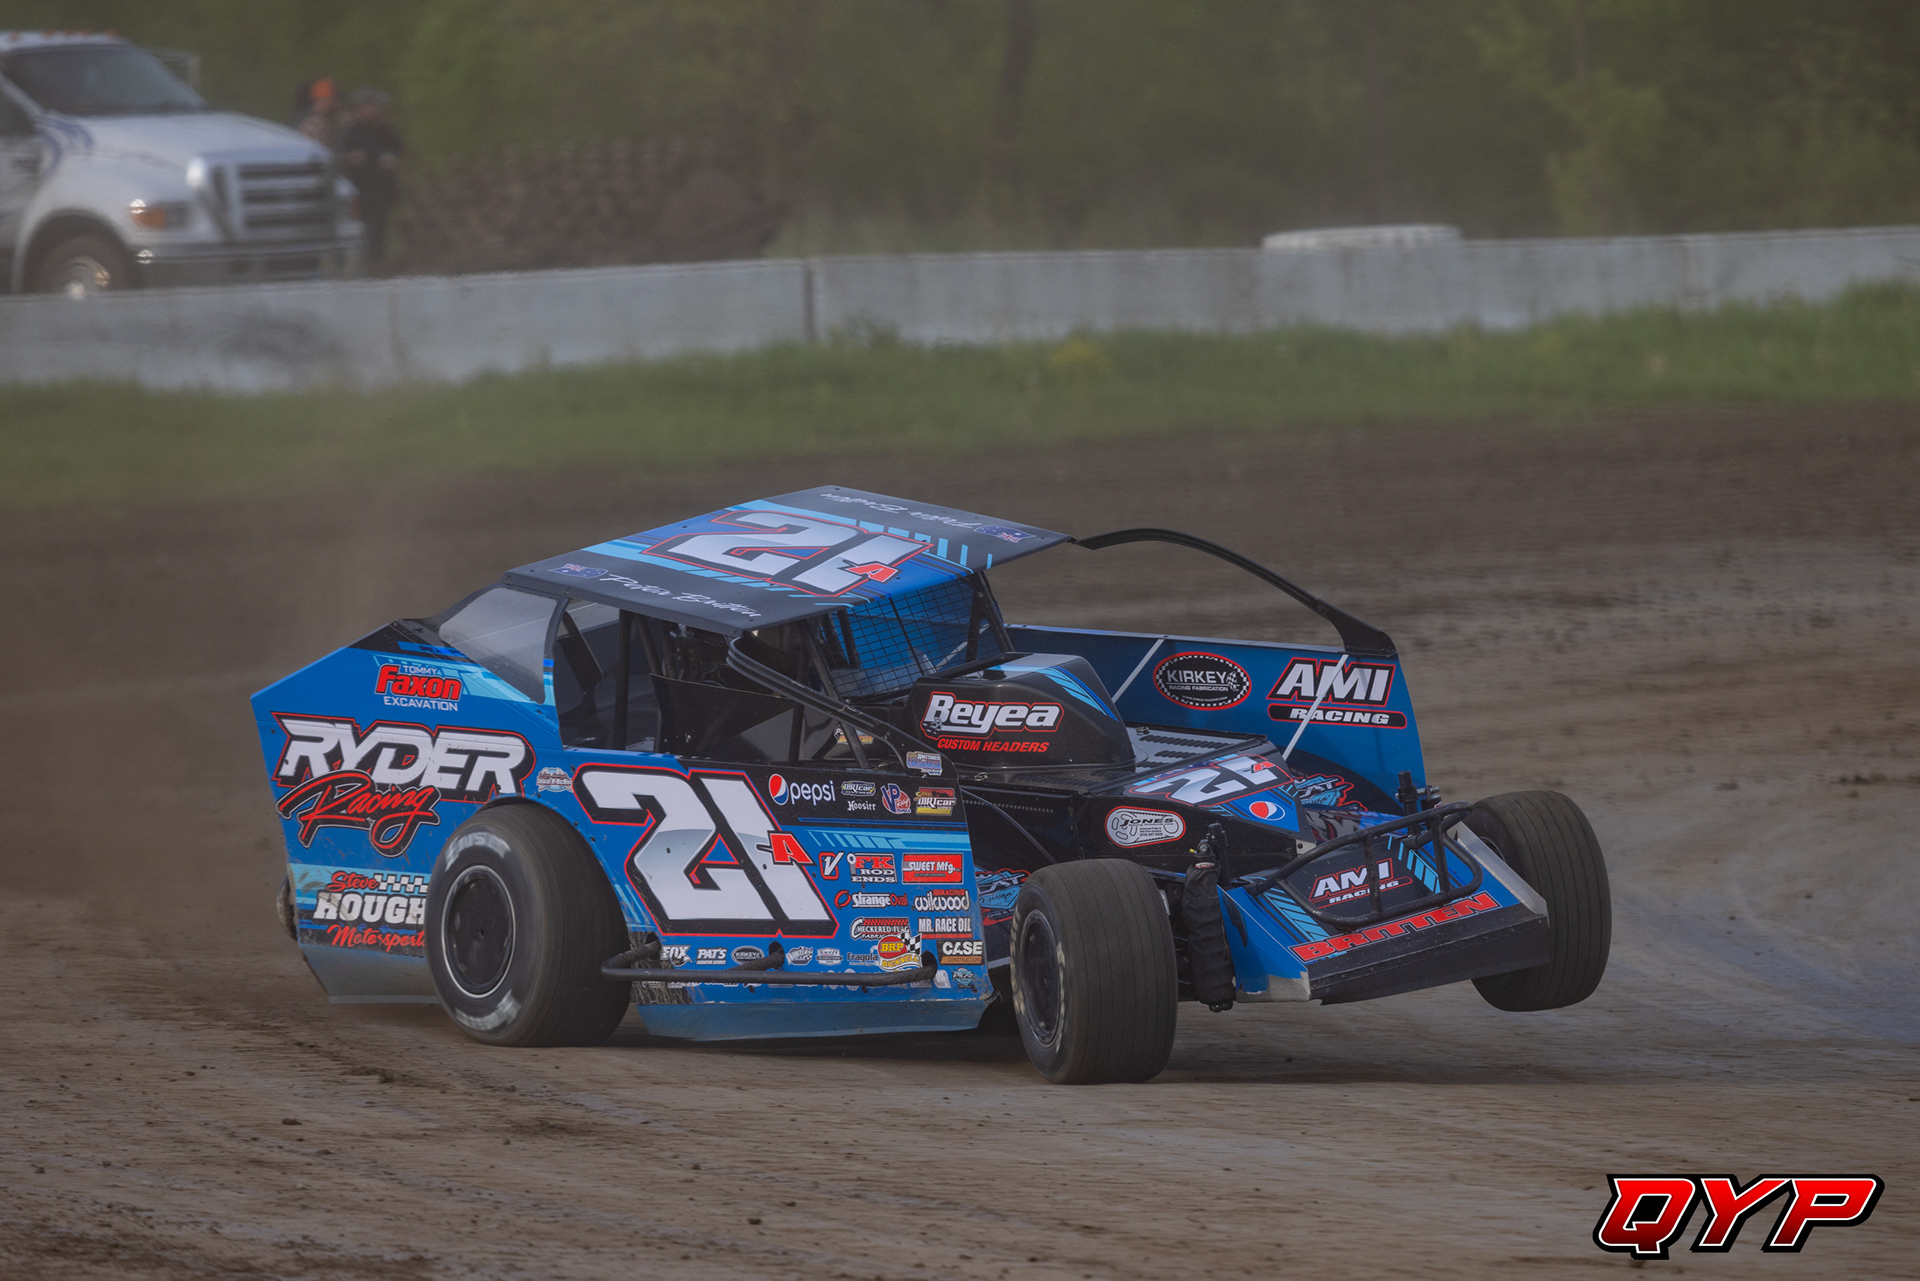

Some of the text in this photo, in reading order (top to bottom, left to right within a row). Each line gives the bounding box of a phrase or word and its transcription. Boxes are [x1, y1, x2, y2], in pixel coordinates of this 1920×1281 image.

[403, 664, 438, 676] TOMMY
[1166, 670, 1227, 684] KIRKEY
[375, 664, 462, 701] Faxon
[1275, 662, 1391, 702] AMI
[383, 696, 459, 711] EXCAVATION
[923, 694, 1057, 734] Beyea
[1289, 708, 1391, 725] RACING
[937, 738, 1050, 753] CUSTOM HEADERS
[278, 718, 527, 794] RYDER
[789, 780, 836, 806] pepsi
[881, 783, 901, 813] VP
[279, 772, 436, 850] Racing
[1120, 818, 1174, 827] JONES
[855, 856, 895, 869] FK
[908, 861, 956, 874] SWEET Mfg.
[325, 870, 379, 892] Steve
[914, 890, 970, 911] wilwood
[851, 918, 892, 939] CHECKERED
[918, 917, 972, 933] MR. RACE OIL
[1291, 892, 1501, 962] BRITTEN
[661, 946, 690, 960] FOX
[697, 948, 728, 959] PAT'S
[880, 942, 904, 952] BRP
[942, 941, 983, 956] CASE
[847, 952, 878, 962] Fragola
[882, 954, 919, 968] BICKNELL
